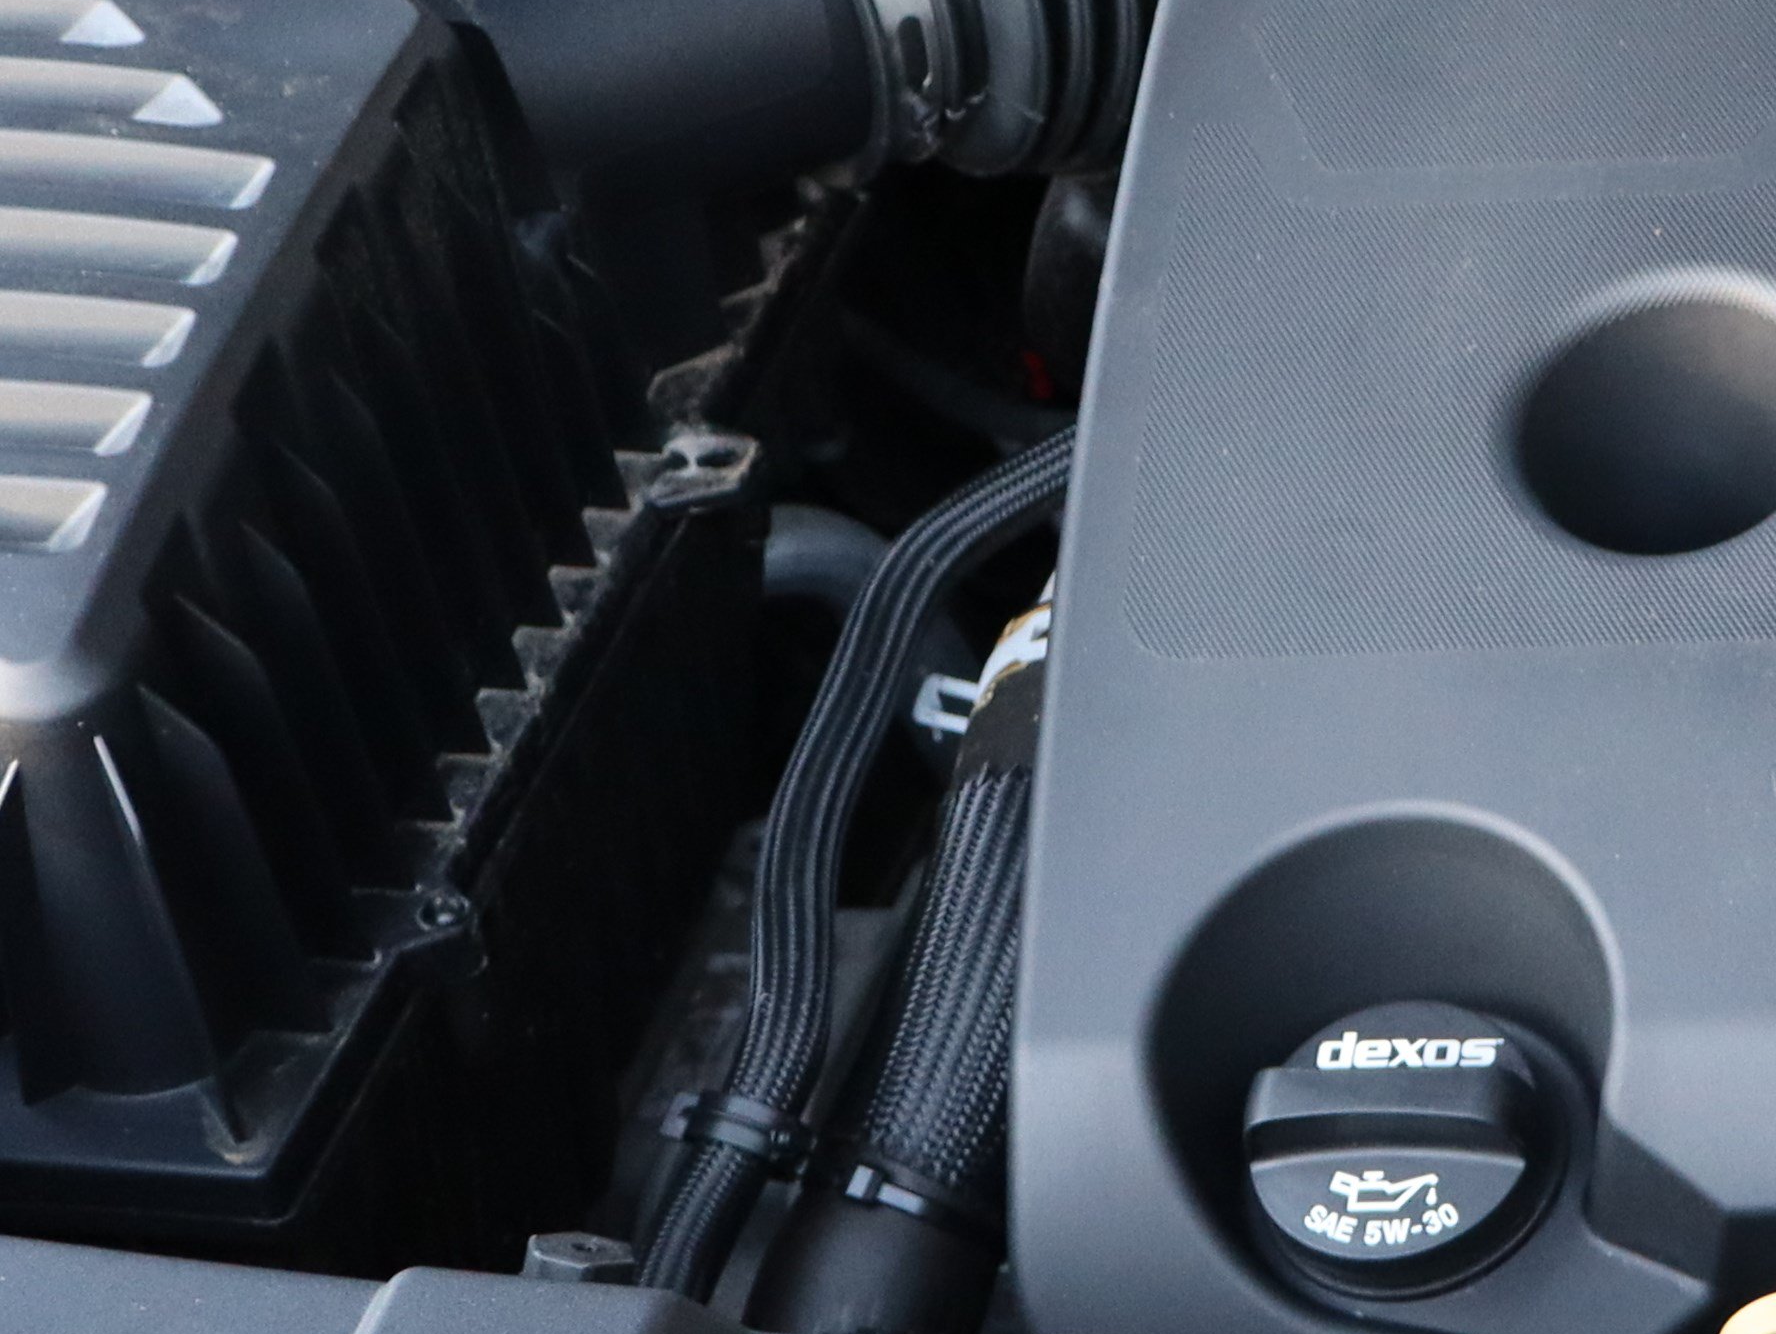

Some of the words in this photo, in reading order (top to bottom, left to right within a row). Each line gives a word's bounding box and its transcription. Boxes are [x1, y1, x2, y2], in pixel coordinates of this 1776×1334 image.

[1316, 1031, 1504, 1071] dexos
[1304, 1204, 1358, 1243] SAE
[1364, 1203, 1459, 1246] 5W-30
